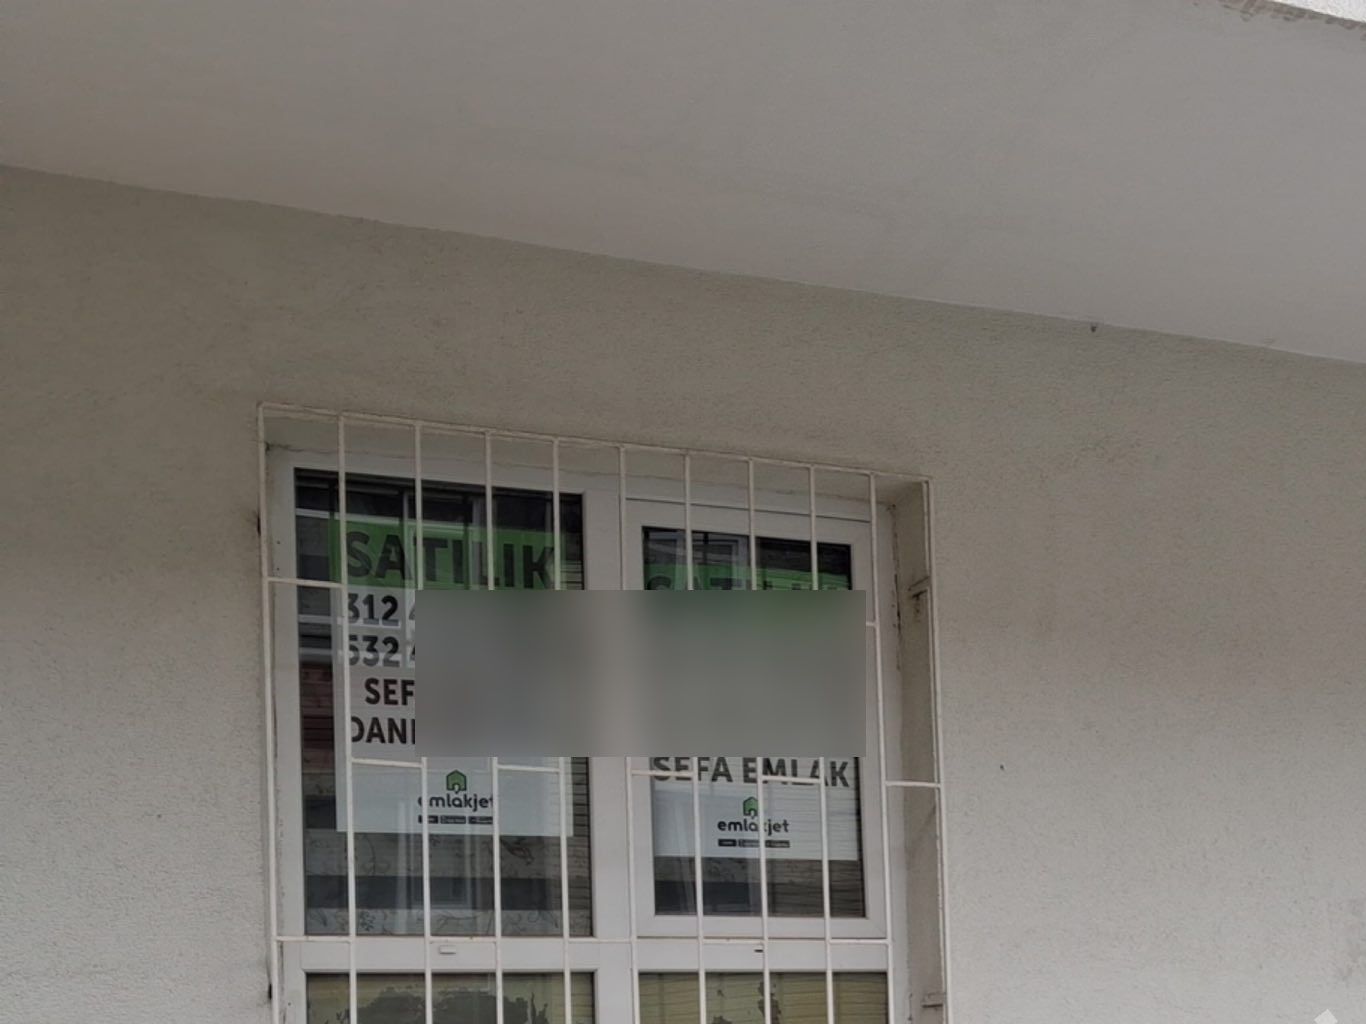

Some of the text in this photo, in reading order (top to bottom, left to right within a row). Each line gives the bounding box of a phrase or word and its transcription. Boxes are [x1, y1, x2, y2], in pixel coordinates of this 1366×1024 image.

[346, 531, 555, 588] SATILIK
[364, 678, 415, 706] SEF
[652, 757, 733, 783] SEFA
